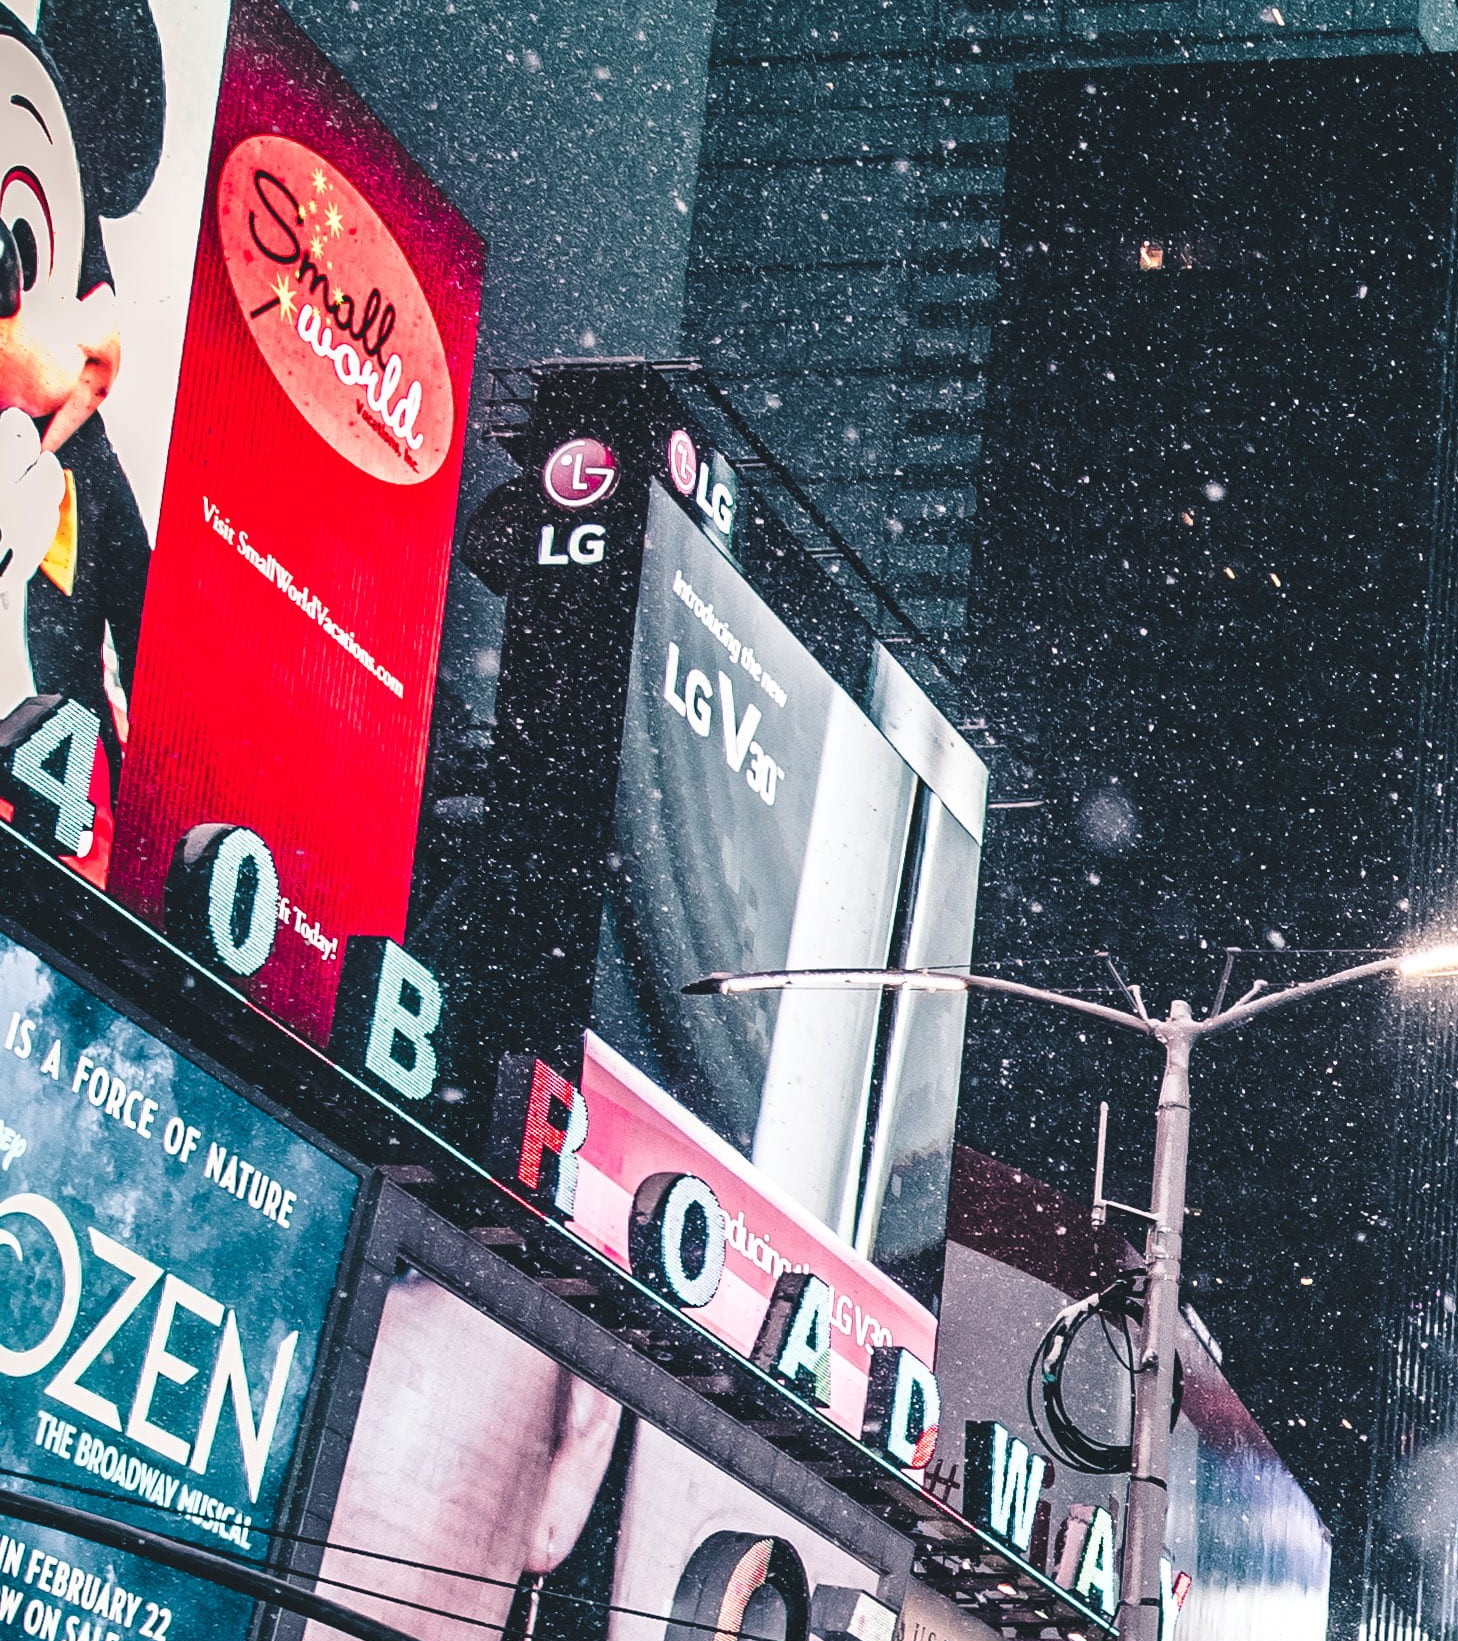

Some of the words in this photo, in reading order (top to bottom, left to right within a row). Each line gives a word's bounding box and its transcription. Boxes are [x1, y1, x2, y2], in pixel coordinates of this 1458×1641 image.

[249, 170, 396, 369] Small
[298, 304, 424, 449] world
[538, 524, 605, 565] LG
[697, 461, 734, 535] LG
[203, 495, 236, 545] Visit
[237, 531, 404, 699] SmallWorldVacations.com
[672, 571, 741, 664] Introducing
[741, 646, 762, 683] the
[762, 668, 789, 708] new
[663, 641, 713, 737] LG
[293, 907, 339, 960] Today!
[4, 1012, 31, 1059] IS
[40, 1039, 61, 1080] A
[72, 1055, 159, 1139] FORCE
[164, 1115, 202, 1164] OF
[205, 1149, 297, 1230] NATURE
[35, 1410, 75, 1462] THE
[75, 1428, 180, 1510] BROADWAY
[178, 1487, 253, 1550] MUSICAL
[25, 1550, 141, 1632] FEBRUARY
